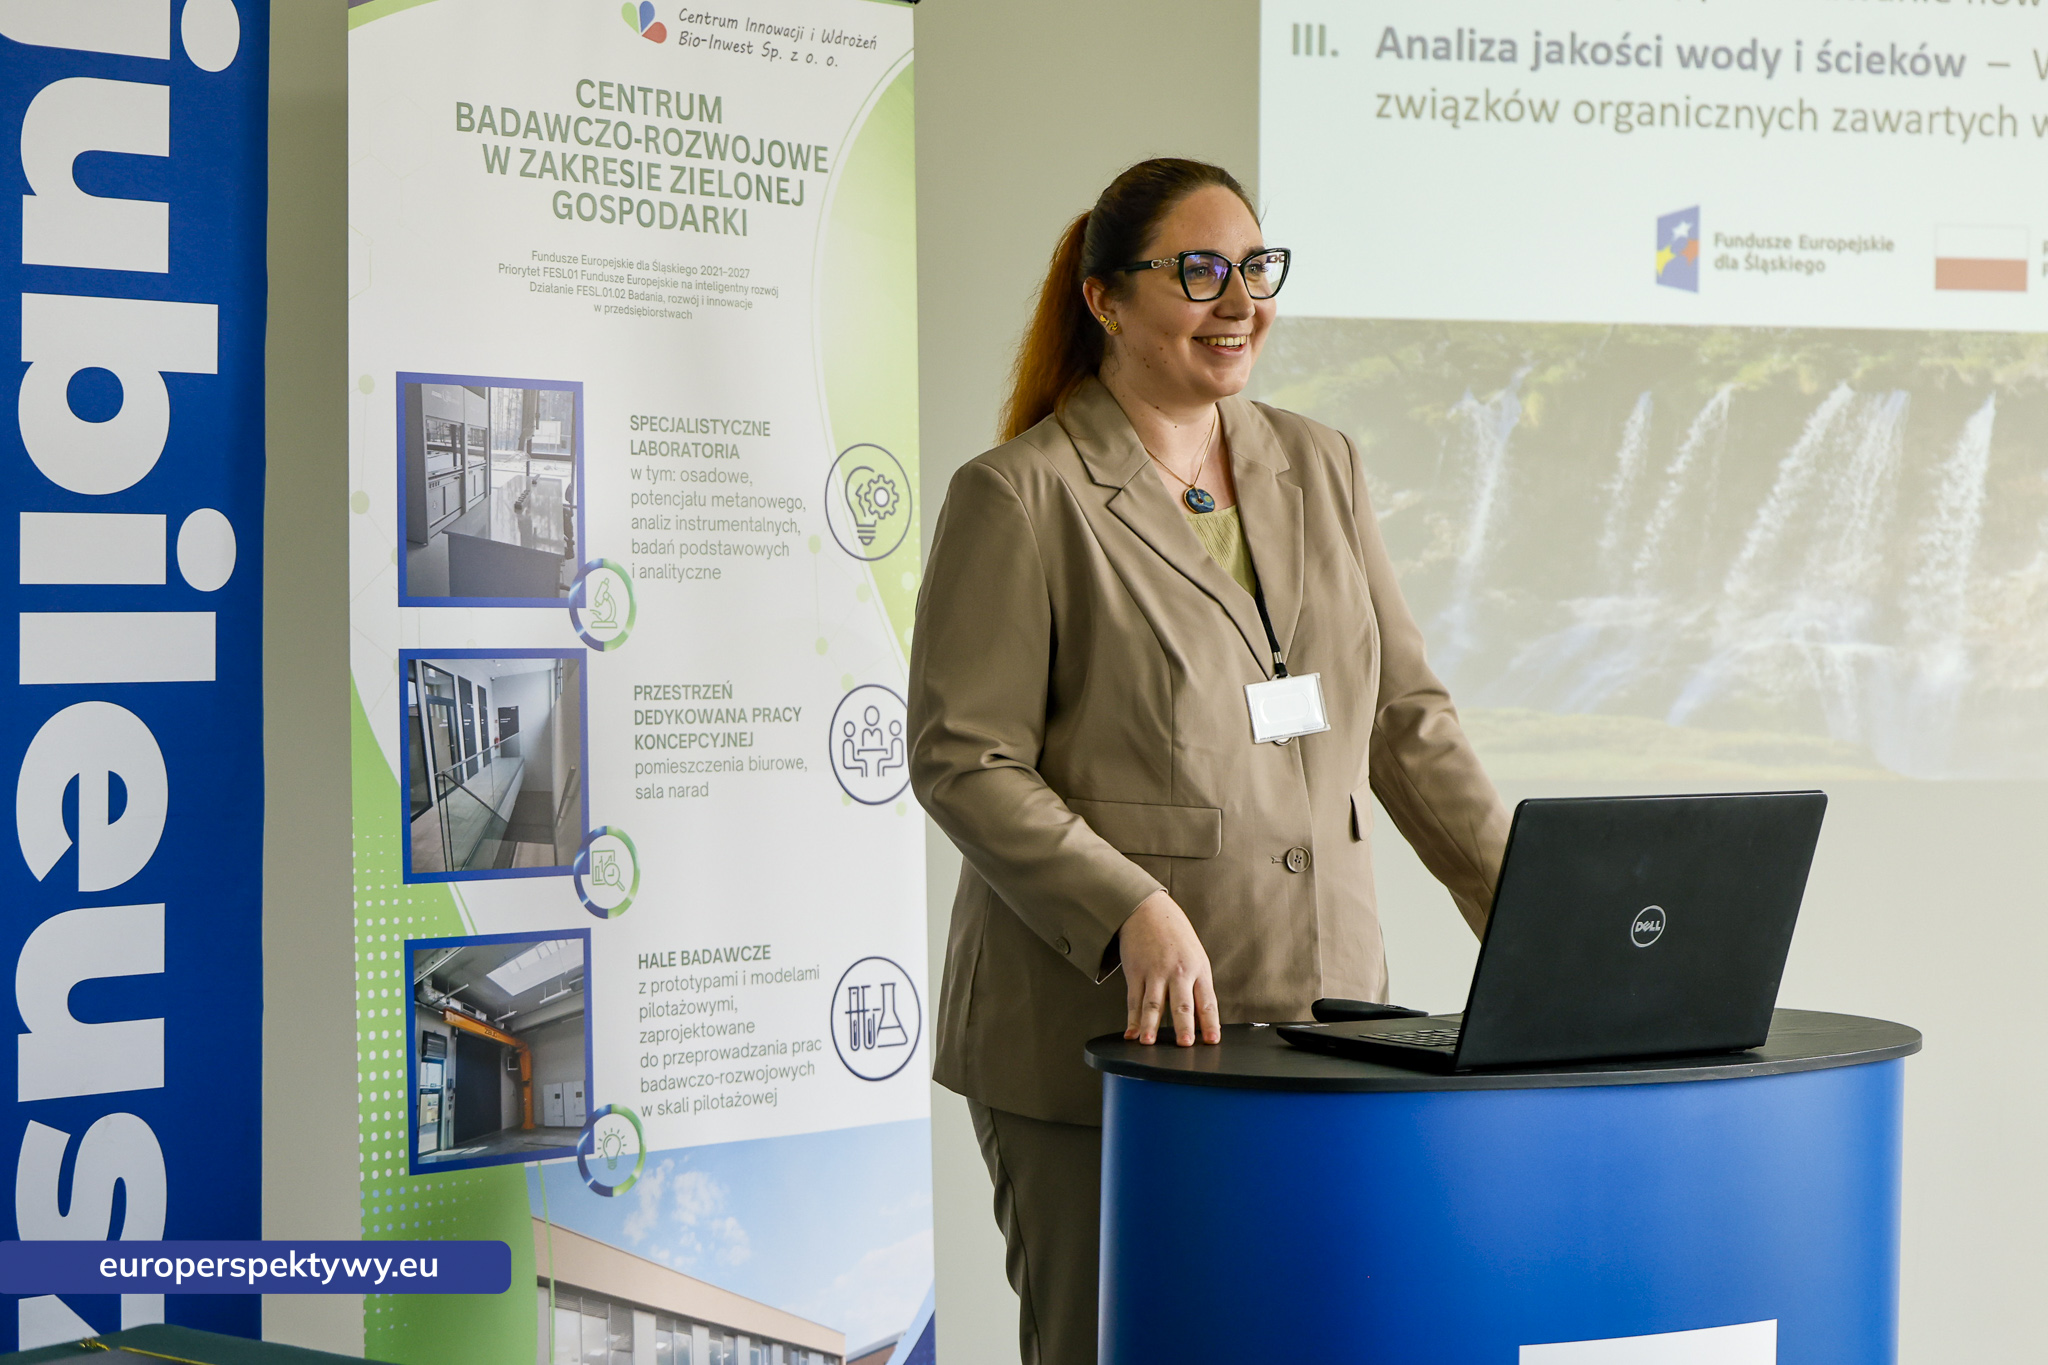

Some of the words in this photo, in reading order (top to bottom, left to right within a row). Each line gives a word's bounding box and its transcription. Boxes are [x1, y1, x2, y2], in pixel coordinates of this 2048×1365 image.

[679, 8, 738, 29] Centrum
[745, 18, 805, 43] Innowacji
[810, 28, 815, 42] i
[821, 28, 877, 50] Wdrożeń
[679, 31, 753, 55] Bio-Inwest
[761, 41, 782, 62] Sp.
[790, 51, 798, 62] z
[805, 54, 818, 65] o.
[826, 56, 838, 67] o.
[1291, 23, 1340, 58] III.
[1375, 26, 1519, 64] Analiza
[1530, 29, 1664, 73] jakości
[1676, 37, 1782, 79] wody
[1795, 39, 1803, 72] i
[1816, 39, 1967, 77] ścieków
[576, 78, 723, 124] CENTRUM
[1374, 88, 1560, 129] związków
[1573, 95, 1819, 138] organicznych
[1831, 104, 2018, 144] zawartych
[455, 101, 829, 173] BADAWCZO-ROZWOJOWE
[482, 143, 511, 175] W
[519, 147, 662, 192] ZAKRESIE
[670, 165, 805, 207] ZIELONEJ
[552, 190, 748, 237] GOSPODARKI
[1713, 232, 1792, 250] Fundusze
[1798, 234, 1895, 254] Europejskie
[531, 250, 579, 265] Fundusze
[581, 254, 634, 270] Europejskie
[636, 260, 650, 271] dla
[652, 258, 698, 277] Śląskiego
[1713, 253, 1739, 271] dla
[1744, 251, 1826, 276] Śląskiego
[499, 263, 541, 278] Priorytet
[581, 270, 625, 284] Fundusze
[627, 274, 679, 290] Europejskie
[681, 280, 693, 290] na
[695, 280, 749, 295] inteligentny
[751, 285, 779, 299] rozwój
[529, 281, 574, 295] Działanie
[628, 290, 666, 304] Badania,
[668, 293, 699, 307] rozwój
[701, 295, 705, 306] i
[706, 296, 753, 310] innowacje
[594, 304, 602, 313] w
[604, 304, 693, 320] przedsiębiorstwach
[630, 414, 771, 437] SPECJALISTYCZNE
[630, 439, 740, 460] LABORATORIA
[630, 467, 642, 480] w
[646, 465, 677, 485] tym:
[680, 466, 753, 486] osadowe,
[631, 490, 707, 509] potencjału
[711, 492, 807, 513] metanowego,
[631, 514, 671, 531] analiz
[675, 514, 801, 537] instrumentalnych,
[631, 538, 675, 555] badań
[679, 539, 790, 560] podstawowych
[631, 563, 636, 579] i
[639, 562, 722, 583] analityczne
[633, 680, 733, 701] PRZESTRZEŃ
[634, 708, 748, 726] DEDYKOWANA
[752, 706, 802, 724] PRACY
[634, 731, 754, 750] KONCEPCYJNEJ
[635, 756, 744, 778] pomieszczenia
[748, 755, 808, 773] biurowe,
[635, 783, 664, 800] sala
[668, 781, 709, 798] narad
[1634, 920, 1661, 933] DELL
[638, 951, 677, 970] HALE
[680, 944, 772, 966] BADAWCZE
[638, 981, 647, 995] z
[650, 971, 739, 996] prototypami
[742, 970, 747, 986] i
[750, 964, 820, 985] modelami
[639, 995, 739, 1023] pilotażowymi,
[639, 1020, 755, 1047] zaprojektowane
[640, 1052, 659, 1069] do
[663, 1040, 788, 1070] przeprowadzania
[791, 1038, 823, 1055] prac
[641, 1060, 815, 1094] badawczo-rozwojowych
[641, 1103, 653, 1118] w
[657, 1095, 689, 1116] skali
[694, 1087, 778, 1116] pilotażowej
